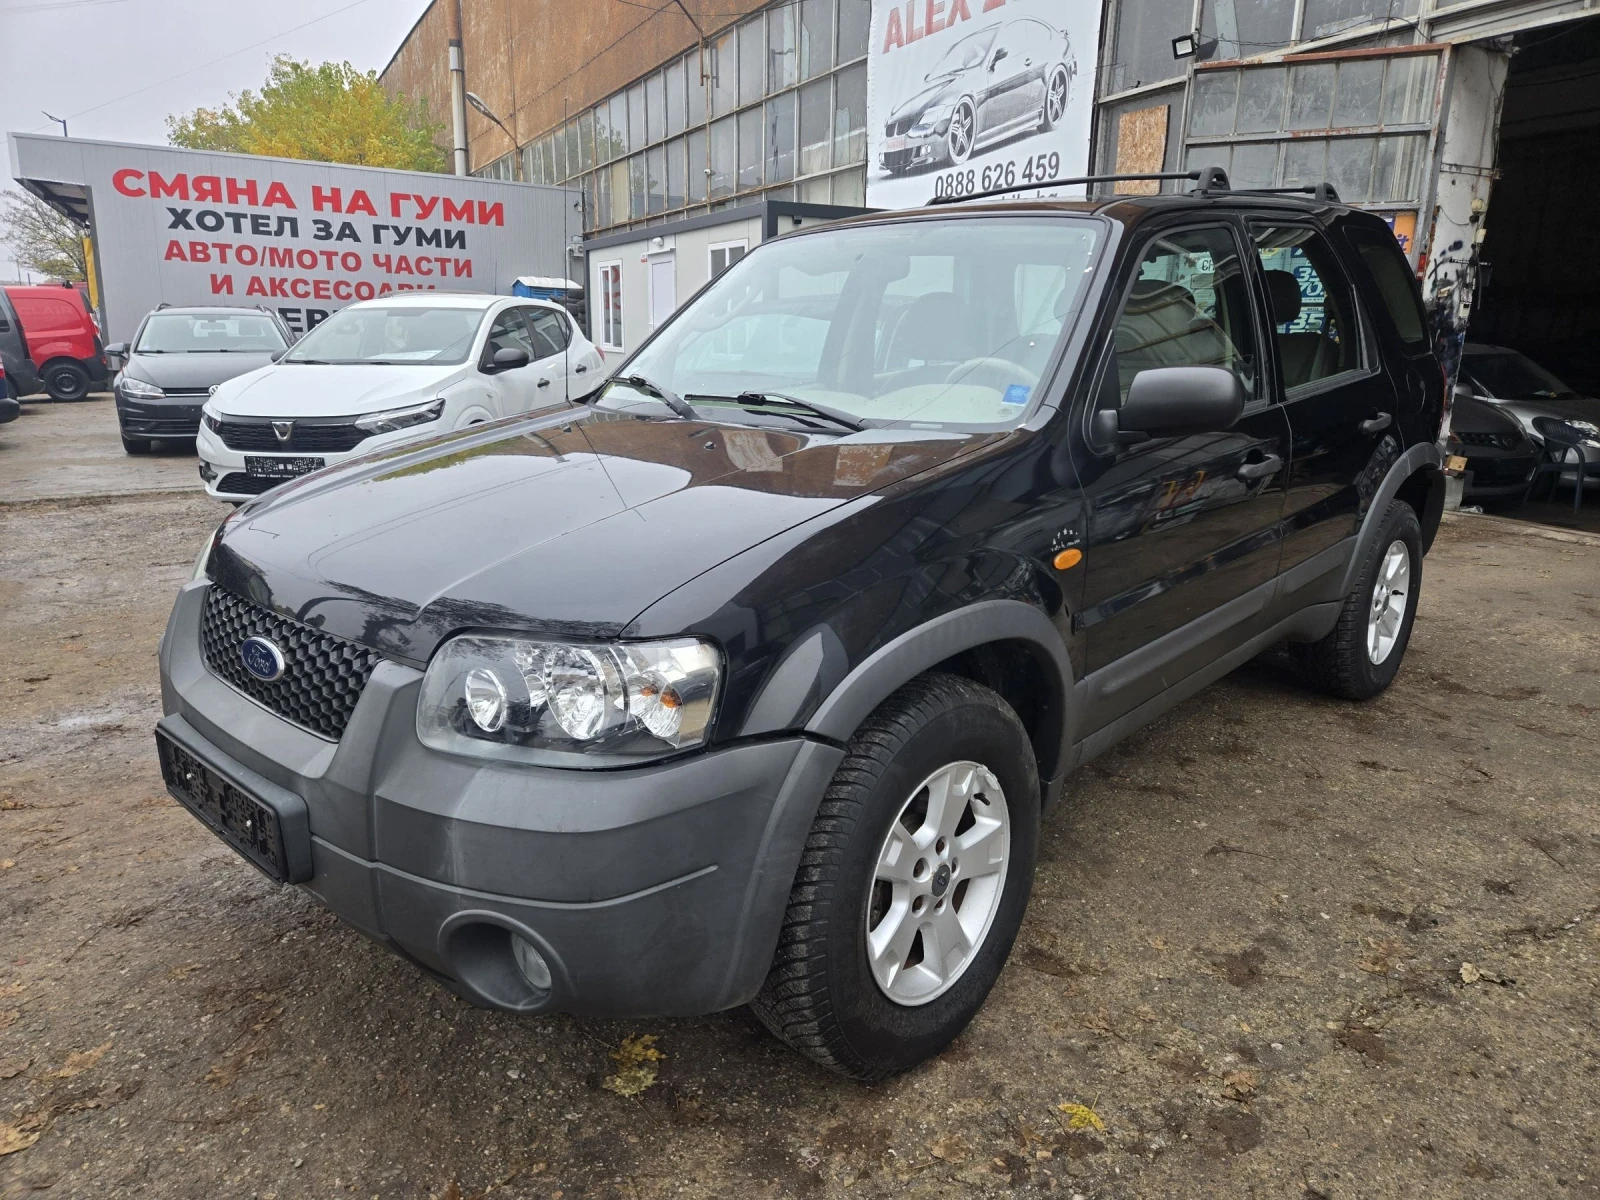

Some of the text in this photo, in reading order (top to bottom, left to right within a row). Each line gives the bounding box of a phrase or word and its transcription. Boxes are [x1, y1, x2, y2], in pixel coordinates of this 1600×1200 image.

[882, 0, 972, 54] ALEX
[935, 151, 1060, 198] 0888 626 459
[112, 168, 505, 227] СМЯНА НА ГУМИ
[166, 207, 467, 250] ХОТЕЛ ЗА ГУМИ
[164, 239, 473, 279] АВТО/МОТО ЧАСТИ
[210, 273, 234, 295] И
